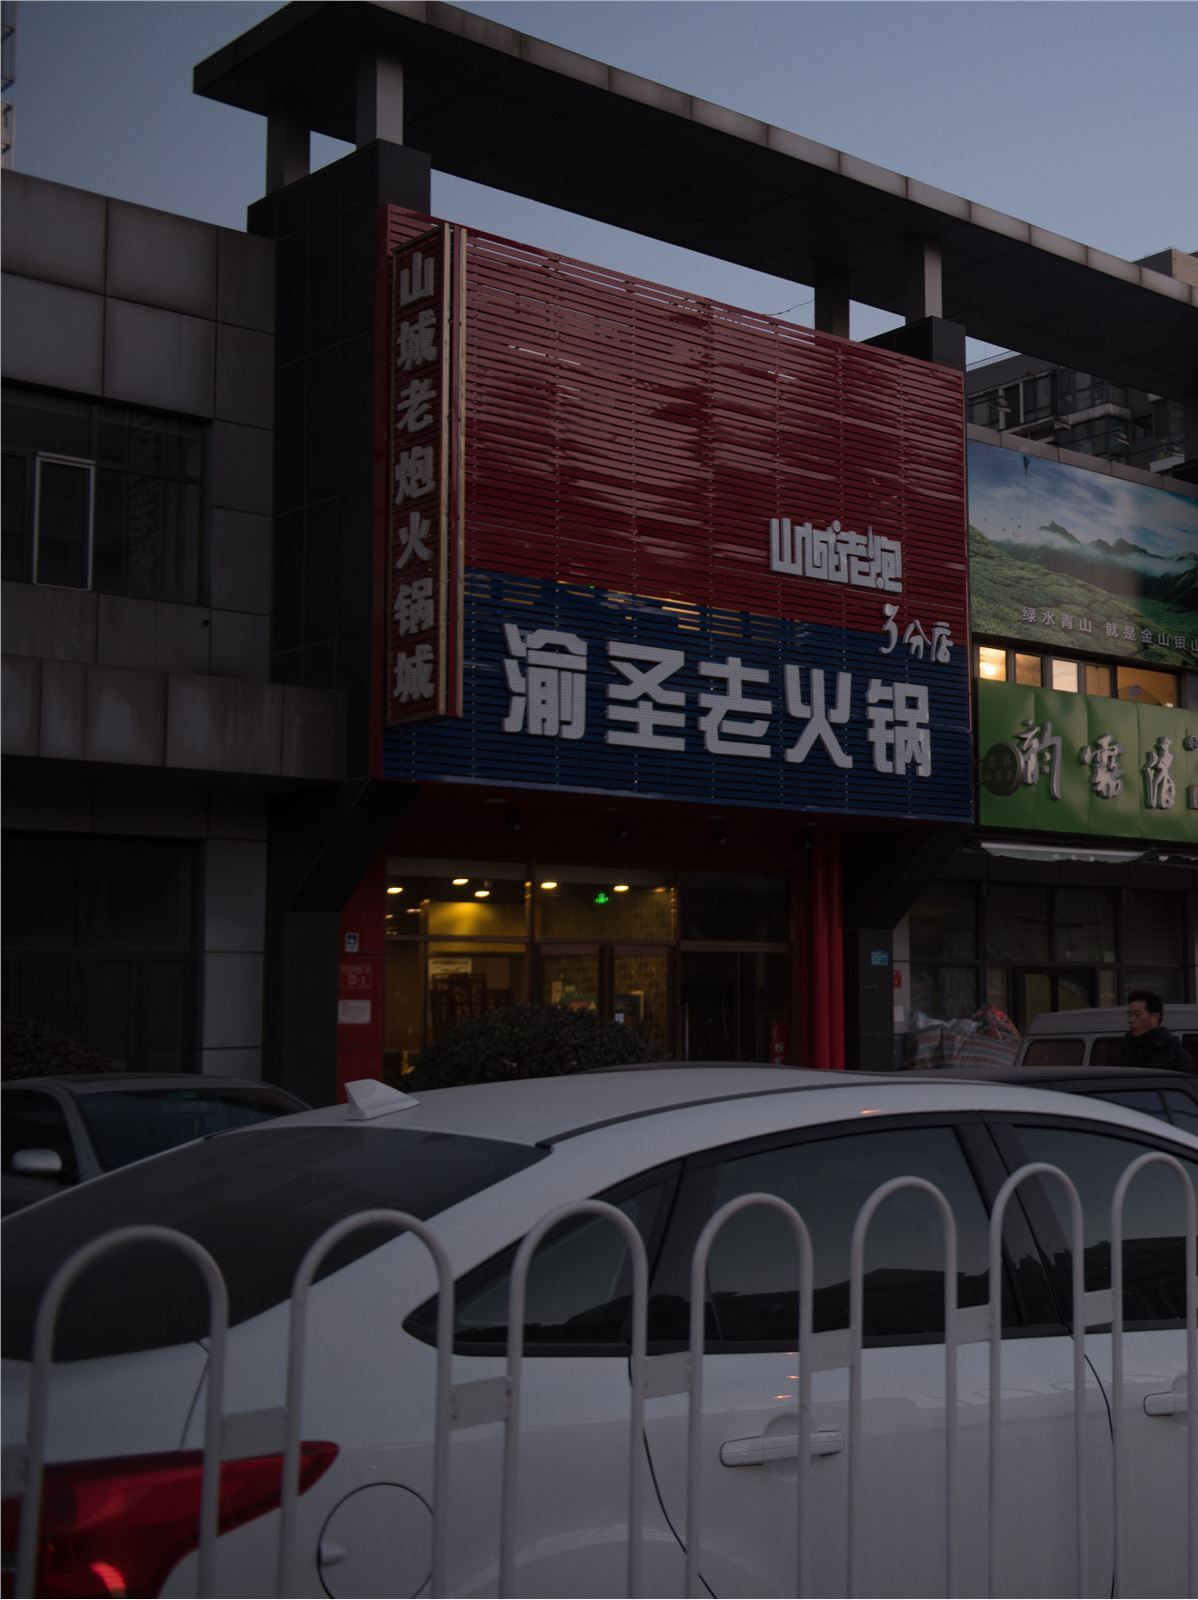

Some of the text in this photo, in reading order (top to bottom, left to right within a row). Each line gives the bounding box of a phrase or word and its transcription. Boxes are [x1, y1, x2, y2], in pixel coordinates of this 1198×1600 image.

[393, 251, 437, 703] 山城老炮火锅城
[1021, 606, 1092, 633] 绿水青山
[503, 623, 931, 777] 渝圣老火锅
